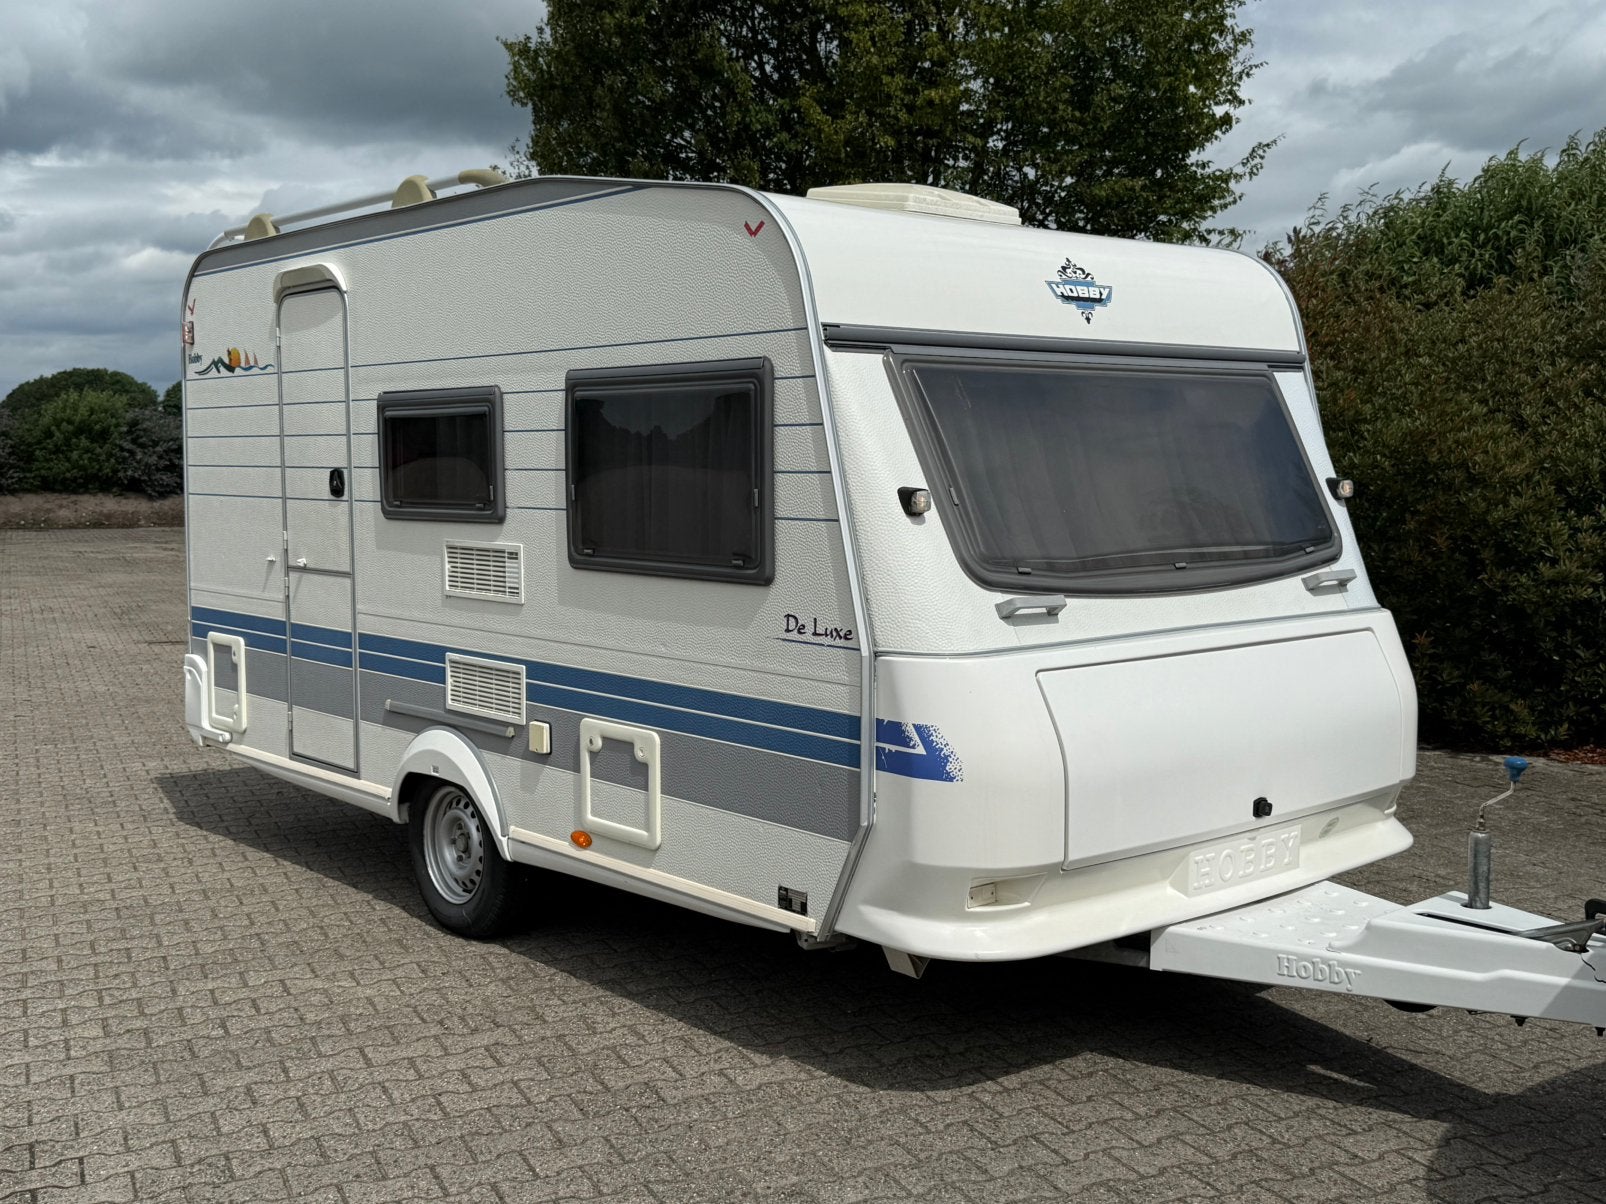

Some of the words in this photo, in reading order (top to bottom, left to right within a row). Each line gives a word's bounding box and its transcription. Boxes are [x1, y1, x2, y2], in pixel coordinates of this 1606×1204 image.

[1050, 283, 1110, 300] HOBBY
[784, 613, 806, 635] De
[812, 617, 854, 641] Luxe
[1192, 832, 1298, 890] HOBBY
[1277, 953, 1362, 992] Hobby
